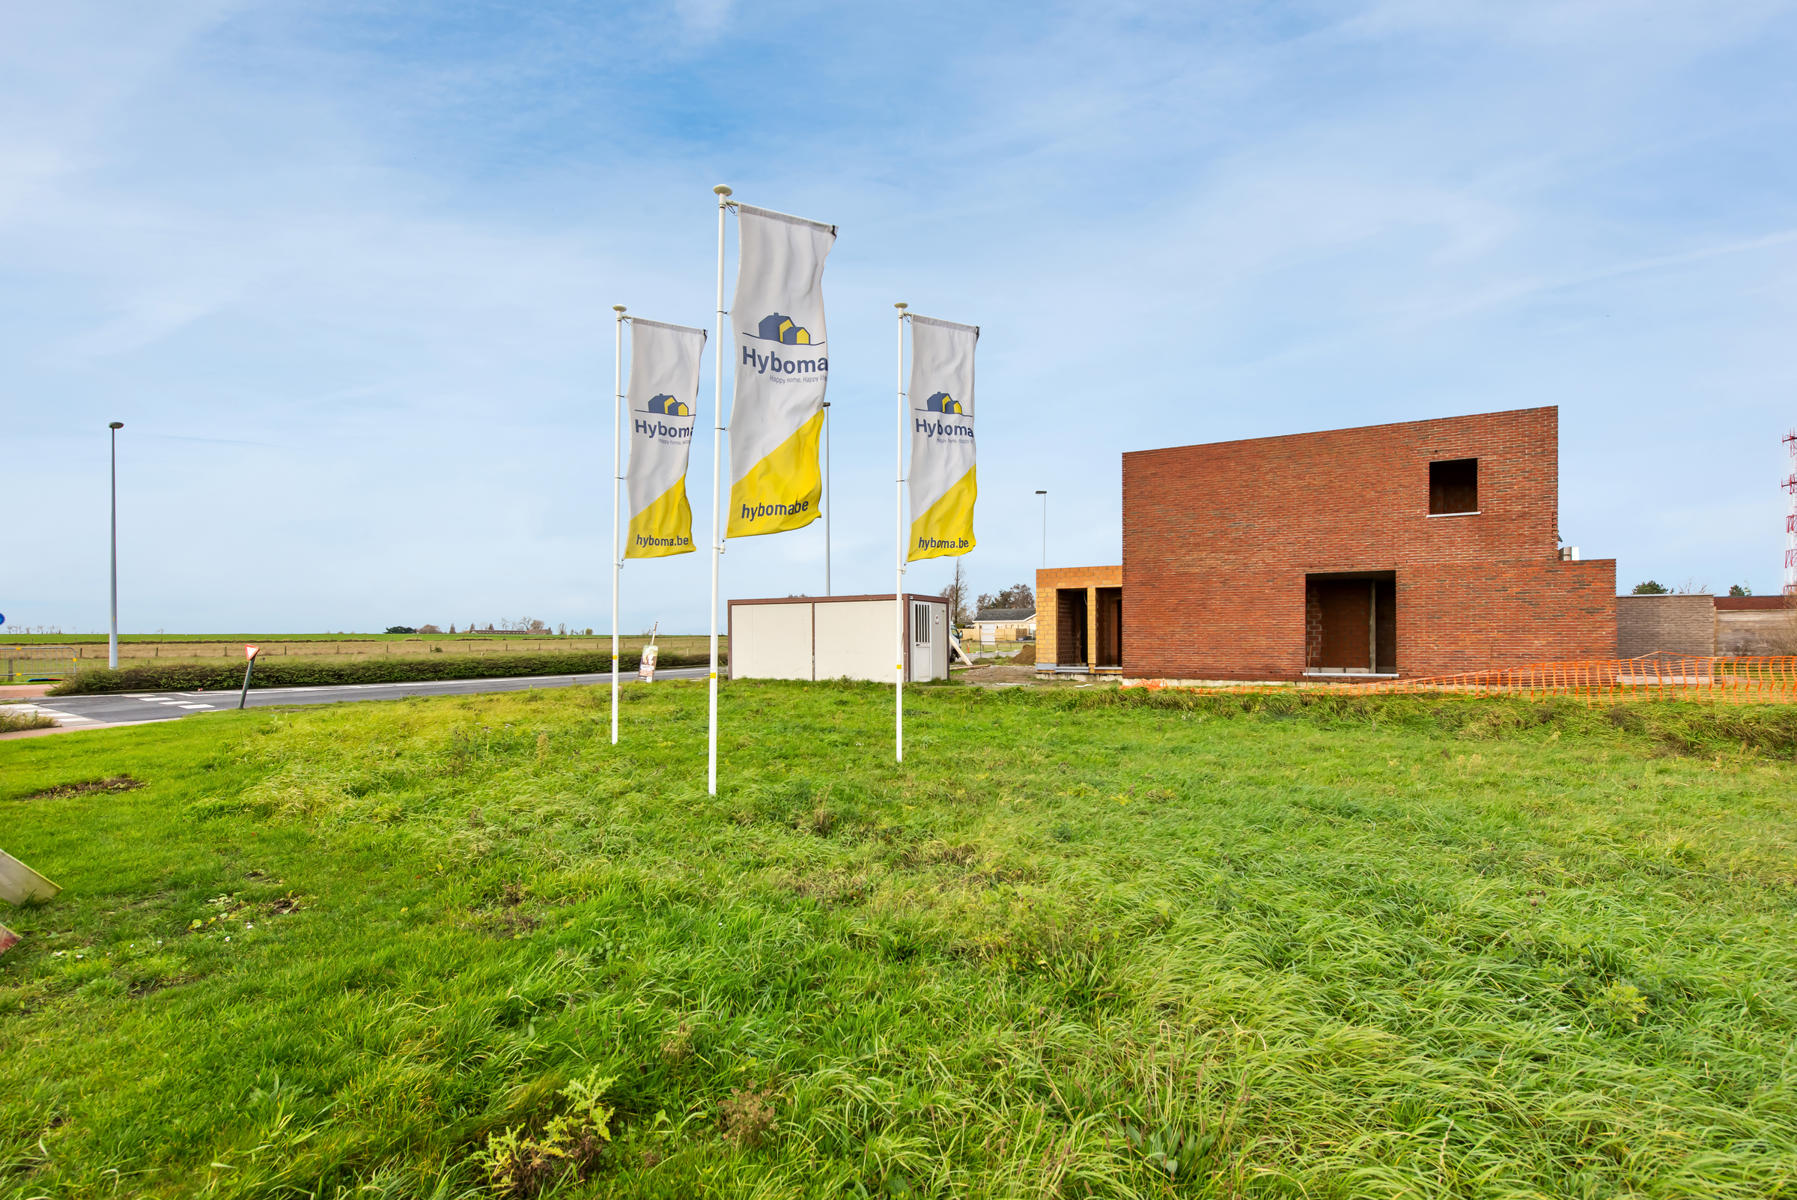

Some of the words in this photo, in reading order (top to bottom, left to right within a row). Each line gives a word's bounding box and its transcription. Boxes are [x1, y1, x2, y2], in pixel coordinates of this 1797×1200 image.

[742, 345, 829, 375] Hyboma
[915, 417, 975, 438] Hyboma
[635, 533, 689, 549] hyboma.be
[918, 536, 970, 551] hyboma.be
